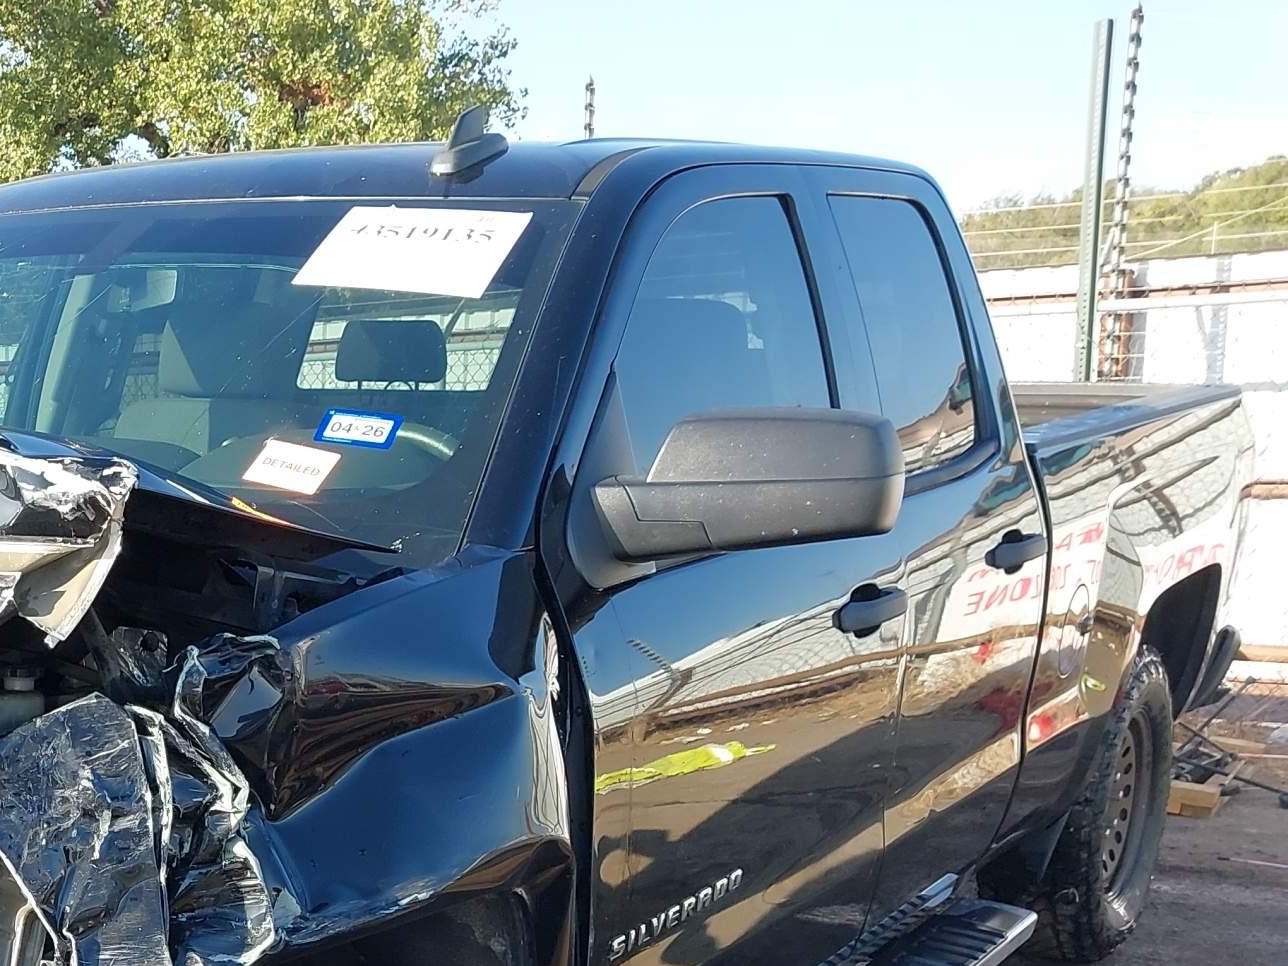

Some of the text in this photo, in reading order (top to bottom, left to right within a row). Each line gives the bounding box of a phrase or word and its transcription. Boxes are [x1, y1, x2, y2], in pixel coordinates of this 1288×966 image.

[330, 421, 386, 437] 04 26
[261, 456, 321, 477] DETAILED
[608, 868, 744, 961] SILVERADO
